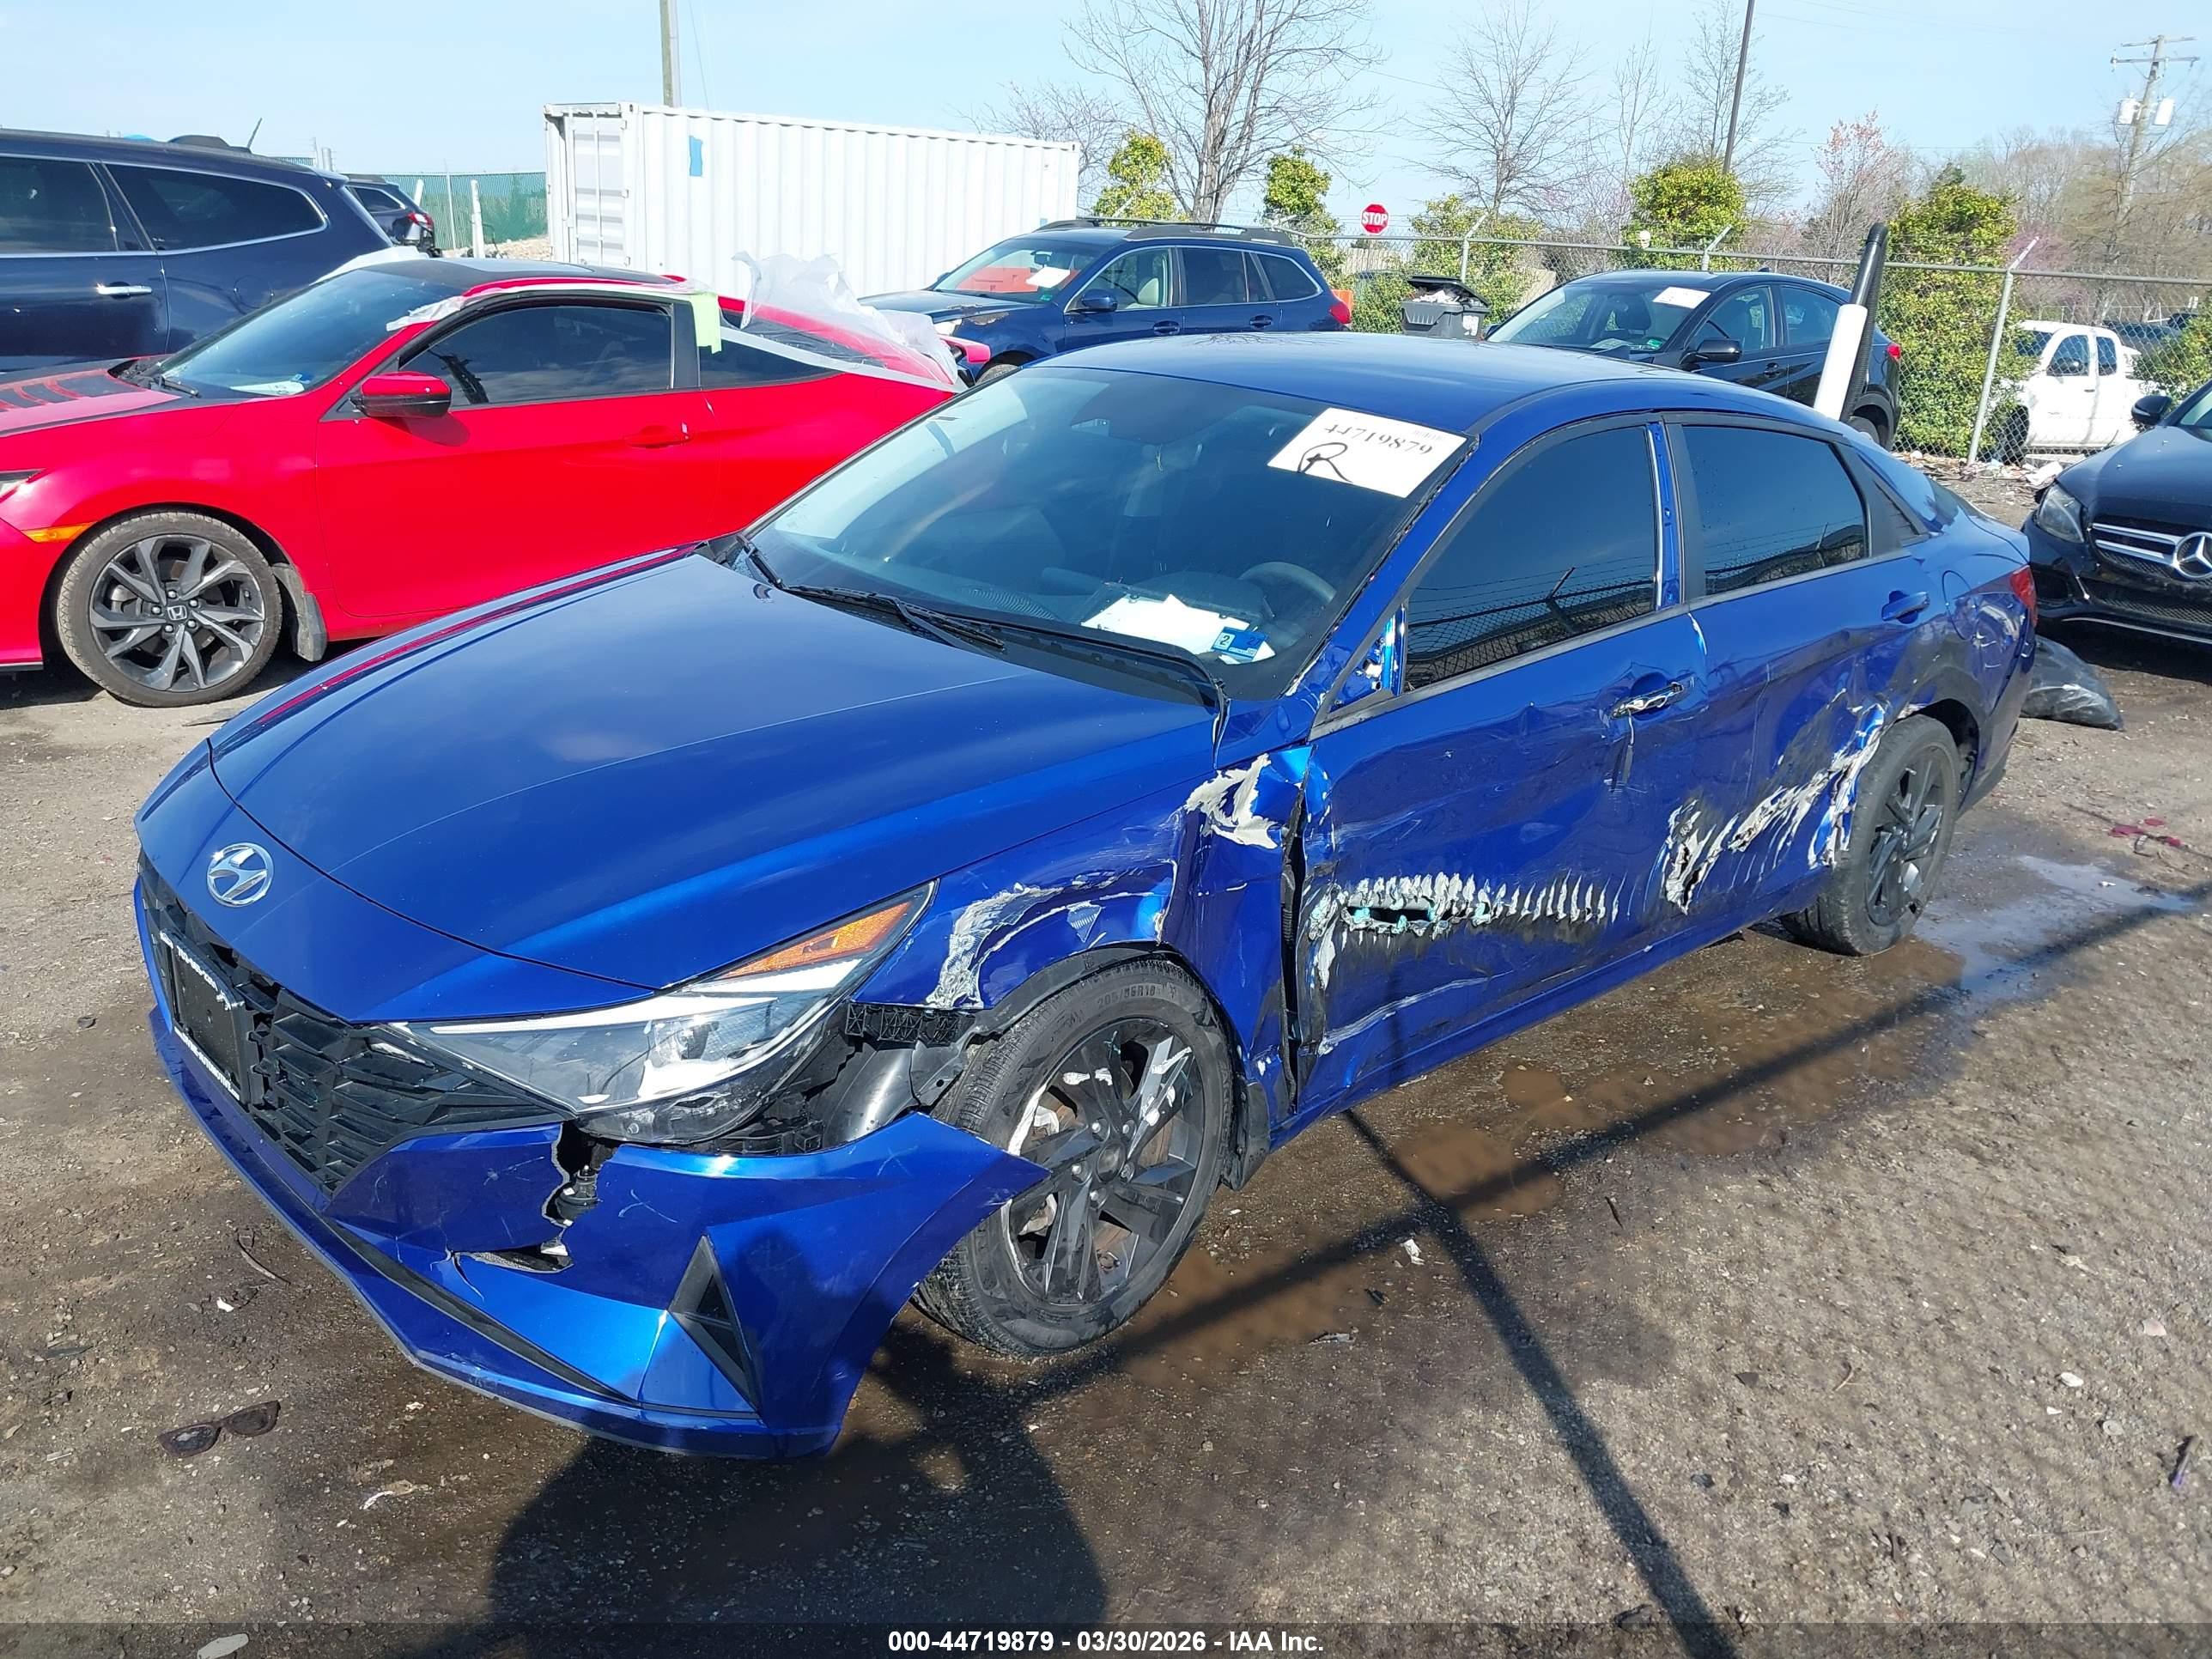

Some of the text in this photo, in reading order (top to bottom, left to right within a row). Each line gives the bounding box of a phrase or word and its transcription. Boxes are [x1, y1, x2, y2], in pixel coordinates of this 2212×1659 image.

[1362, 211, 1388, 225] STOP
[1324, 424, 1433, 455] 44719879
[1219, 635, 1231, 646] 2
